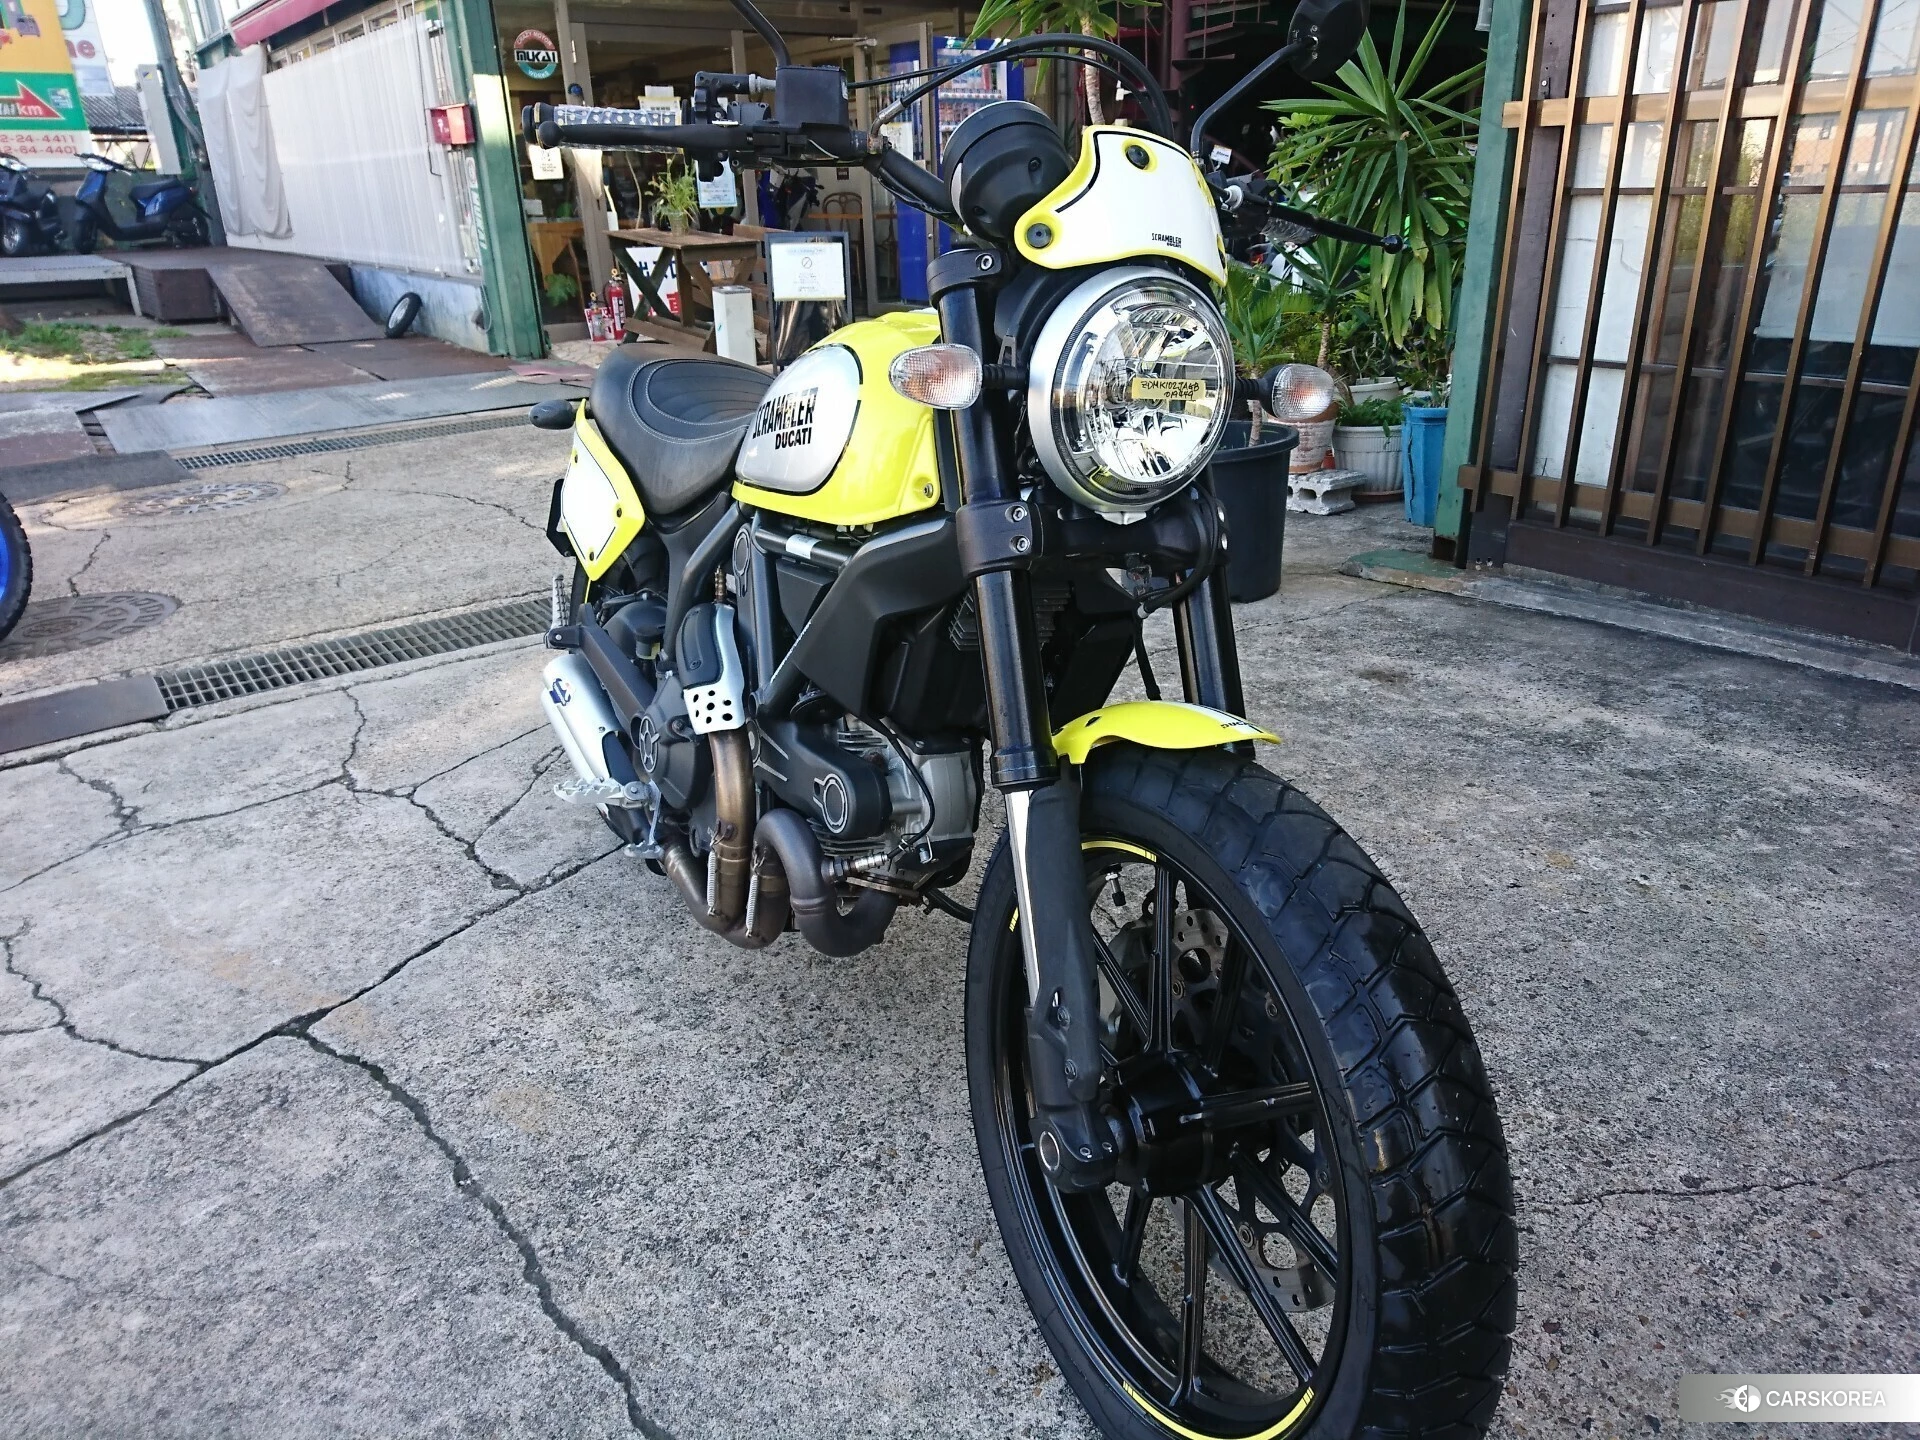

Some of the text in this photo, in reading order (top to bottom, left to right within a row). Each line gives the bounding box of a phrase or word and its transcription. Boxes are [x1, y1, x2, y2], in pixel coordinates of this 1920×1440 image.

[516, 51, 556, 62] MUKAI
[1151, 232, 1182, 245] SCRAMBLER
[774, 426, 813, 451] DUCATI
